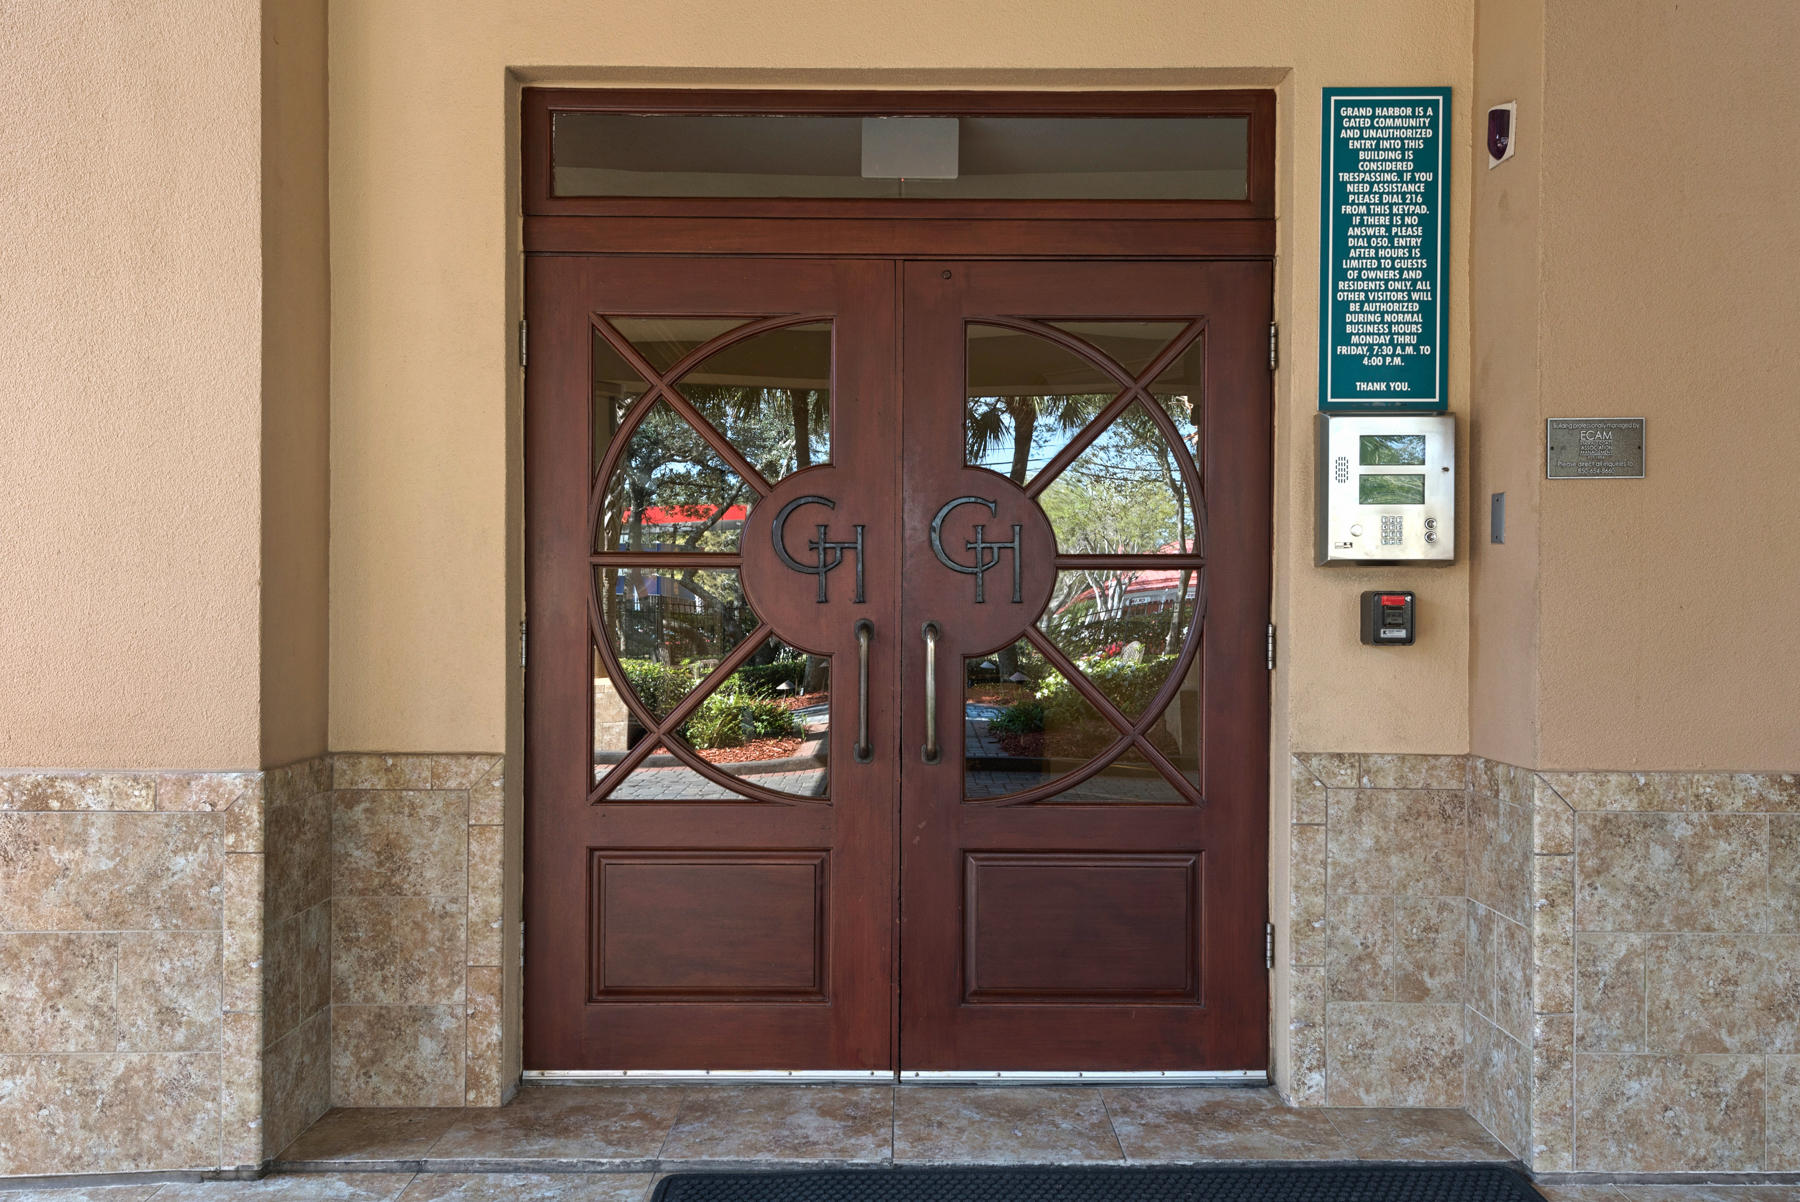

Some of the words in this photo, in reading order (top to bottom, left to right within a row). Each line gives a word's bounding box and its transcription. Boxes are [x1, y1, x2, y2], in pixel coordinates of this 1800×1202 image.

[1340, 107, 1372, 116] GRAND
[1376, 107, 1412, 116] HARBOR
[1416, 107, 1424, 116] IS
[1427, 107, 1433, 116] A
[1343, 118, 1371, 127] GATED
[1374, 118, 1430, 127] COMMUNITY
[1340, 129, 1360, 138] AND
[1363, 129, 1432, 138] UNAUTHORIZED
[1349, 140, 1377, 148] ENTRY
[1380, 140, 1401, 148] INTO
[1404, 140, 1424, 148] THIS
[1359, 151, 1402, 159] BUILDING
[1405, 151, 1413, 159] IS
[1358, 162, 1413, 170] CONSIDERED
[1339, 172, 1400, 181] TRESPASSING.
[1404, 172, 1411, 181] IF
[1414, 172, 1432, 181] YOU
[1347, 183, 1370, 192] NEED
[1372, 183, 1424, 192] ASSISTANCE
[1349, 194, 1379, 203] PLEASE
[1383, 194, 1402, 203] DIAL
[1406, 194, 1422, 203] 216
[1342, 205, 1367, 214] FROM
[1370, 205, 1389, 214] THIS
[1393, 205, 1429, 214] KEYPAD.
[1353, 216, 1360, 225] IF
[1363, 216, 1390, 225] THERE
[1393, 216, 1401, 225] IS
[1405, 216, 1418, 225] NO
[1348, 227, 1388, 235] ANSWER.
[1392, 227, 1422, 235] PLEASE
[1348, 238, 1368, 246] DIAL
[1371, 238, 1391, 246] 050.
[1394, 238, 1422, 246] ENTRY
[1349, 248, 1375, 257] AFTER
[1379, 248, 1409, 257] HOURS
[1412, 248, 1420, 257] IS
[1343, 259, 1378, 268] LIMITED
[1380, 259, 1392, 268] TO
[1395, 259, 1427, 268] GUESTS
[1347, 270, 1358, 279] OF
[1361, 270, 1399, 279] OWNERS
[1402, 270, 1422, 279] AND
[1339, 281, 1385, 290] RESIDENTS
[1388, 281, 1413, 290] ONLY.
[1416, 281, 1431, 290] ALL
[1337, 292, 1365, 300] OTHER
[1368, 292, 1408, 300] VISITORS
[1411, 292, 1432, 300] WILL
[1350, 303, 1360, 311] BE
[1363, 303, 1419, 311] AUTHORIZED
[1346, 314, 1381, 322] DURING
[1384, 314, 1423, 322] NORMAL
[1346, 324, 1388, 333] BUSINESS
[1392, 324, 1422, 333] HOURS
[1351, 335, 1390, 344] MONDAY
[1393, 335, 1417, 344] THRU
[1337, 346, 1369, 355] FRIDAY,
[1373, 346, 1393, 355] 7:30
[1396, 346, 1416, 355] A.M.
[1420, 346, 1431, 355] TO
[1363, 357, 1383, 365] 4:00
[1386, 357, 1404, 365] P.M.
[1356, 382, 1386, 391] THANK
[1389, 382, 1410, 391] YOU.
[1580, 430, 1612, 440] ECAM
